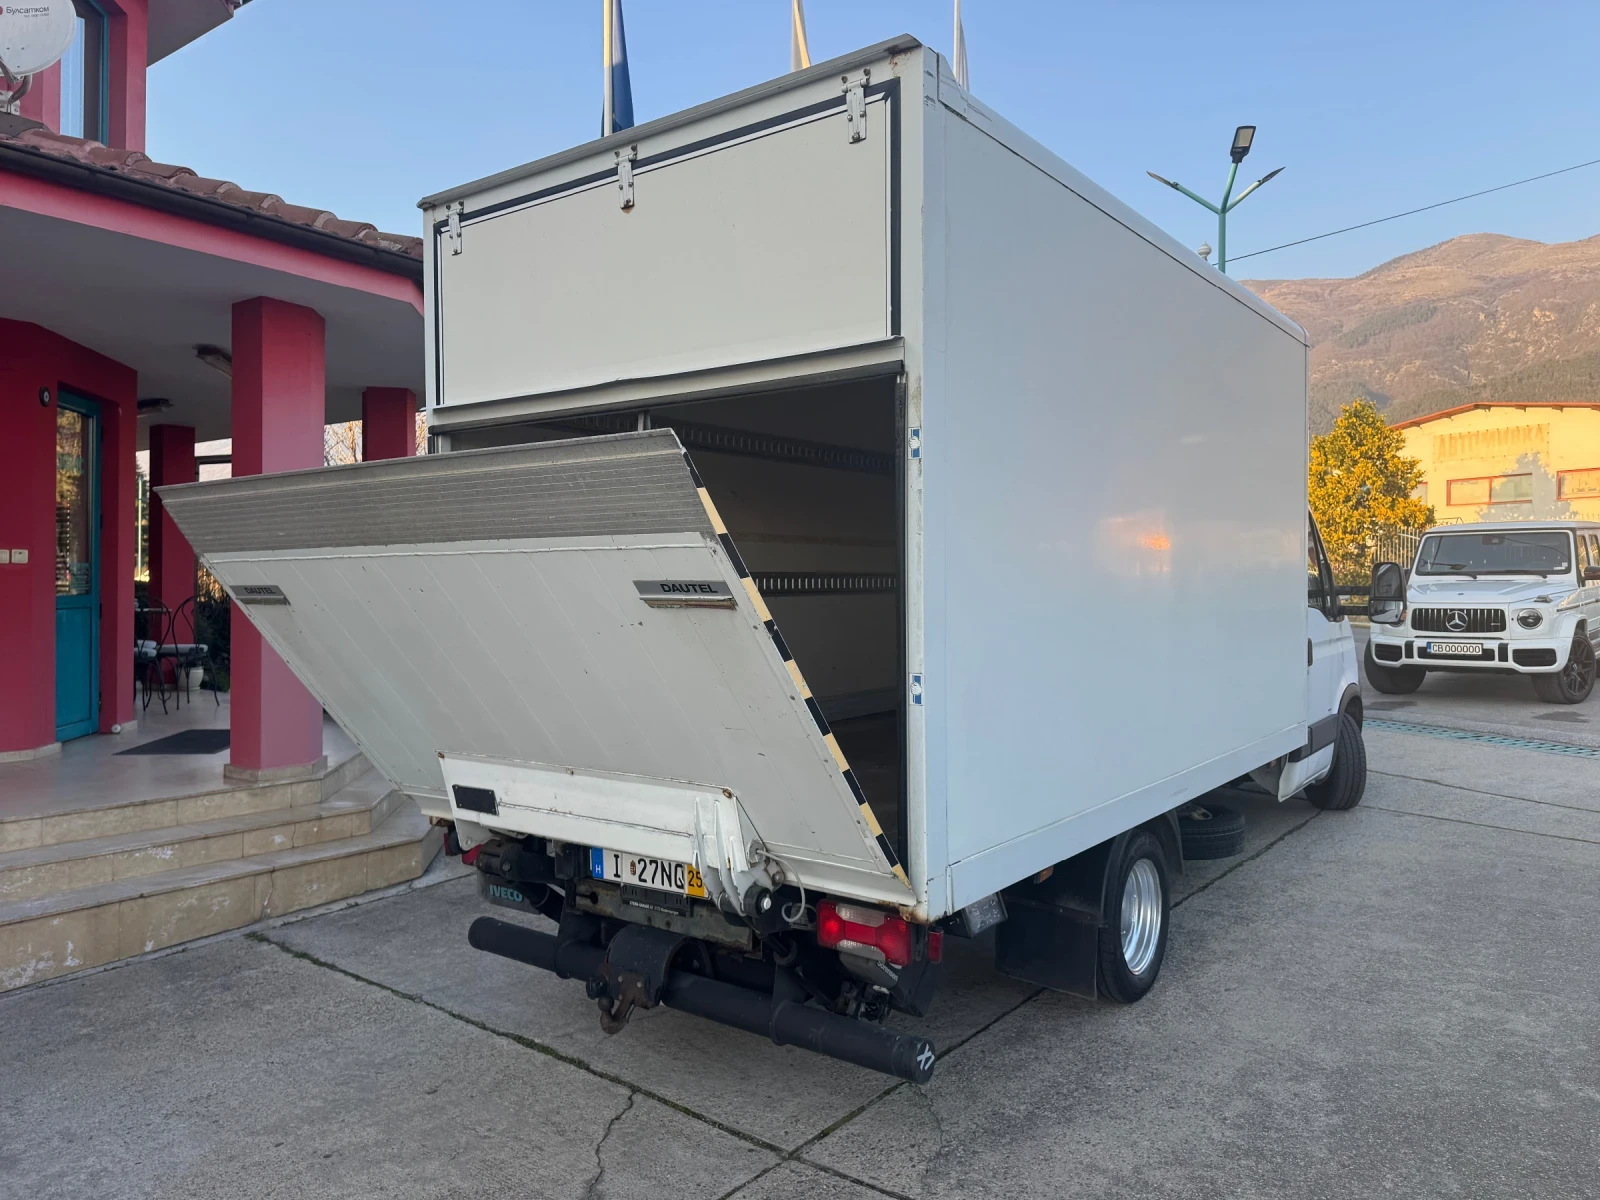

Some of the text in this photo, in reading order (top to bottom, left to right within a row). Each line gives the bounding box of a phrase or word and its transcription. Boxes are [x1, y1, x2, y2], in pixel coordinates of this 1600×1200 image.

[6, 6, 49, 15] Булсатком
[660, 583, 719, 594] DAUTEL
[595, 864, 601, 874] H
[688, 870, 703, 888] 25
[489, 884, 523, 903] IVECO
